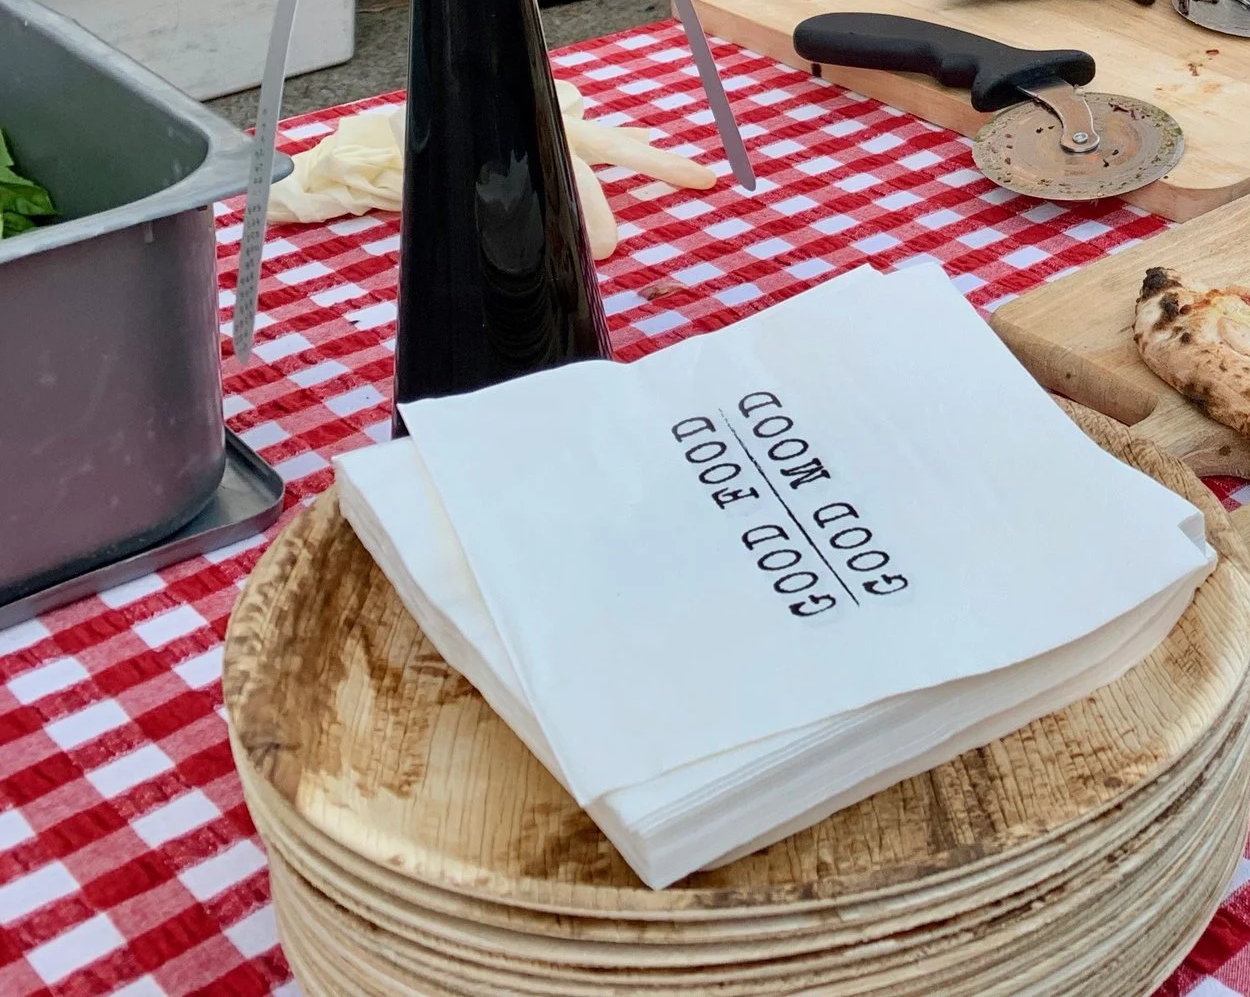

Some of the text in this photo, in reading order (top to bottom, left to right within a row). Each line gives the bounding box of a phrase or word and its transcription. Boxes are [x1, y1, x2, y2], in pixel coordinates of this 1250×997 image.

[671, 416, 837, 617] GOOD FOOD
[738, 391, 909, 595] GOOD MOOD
